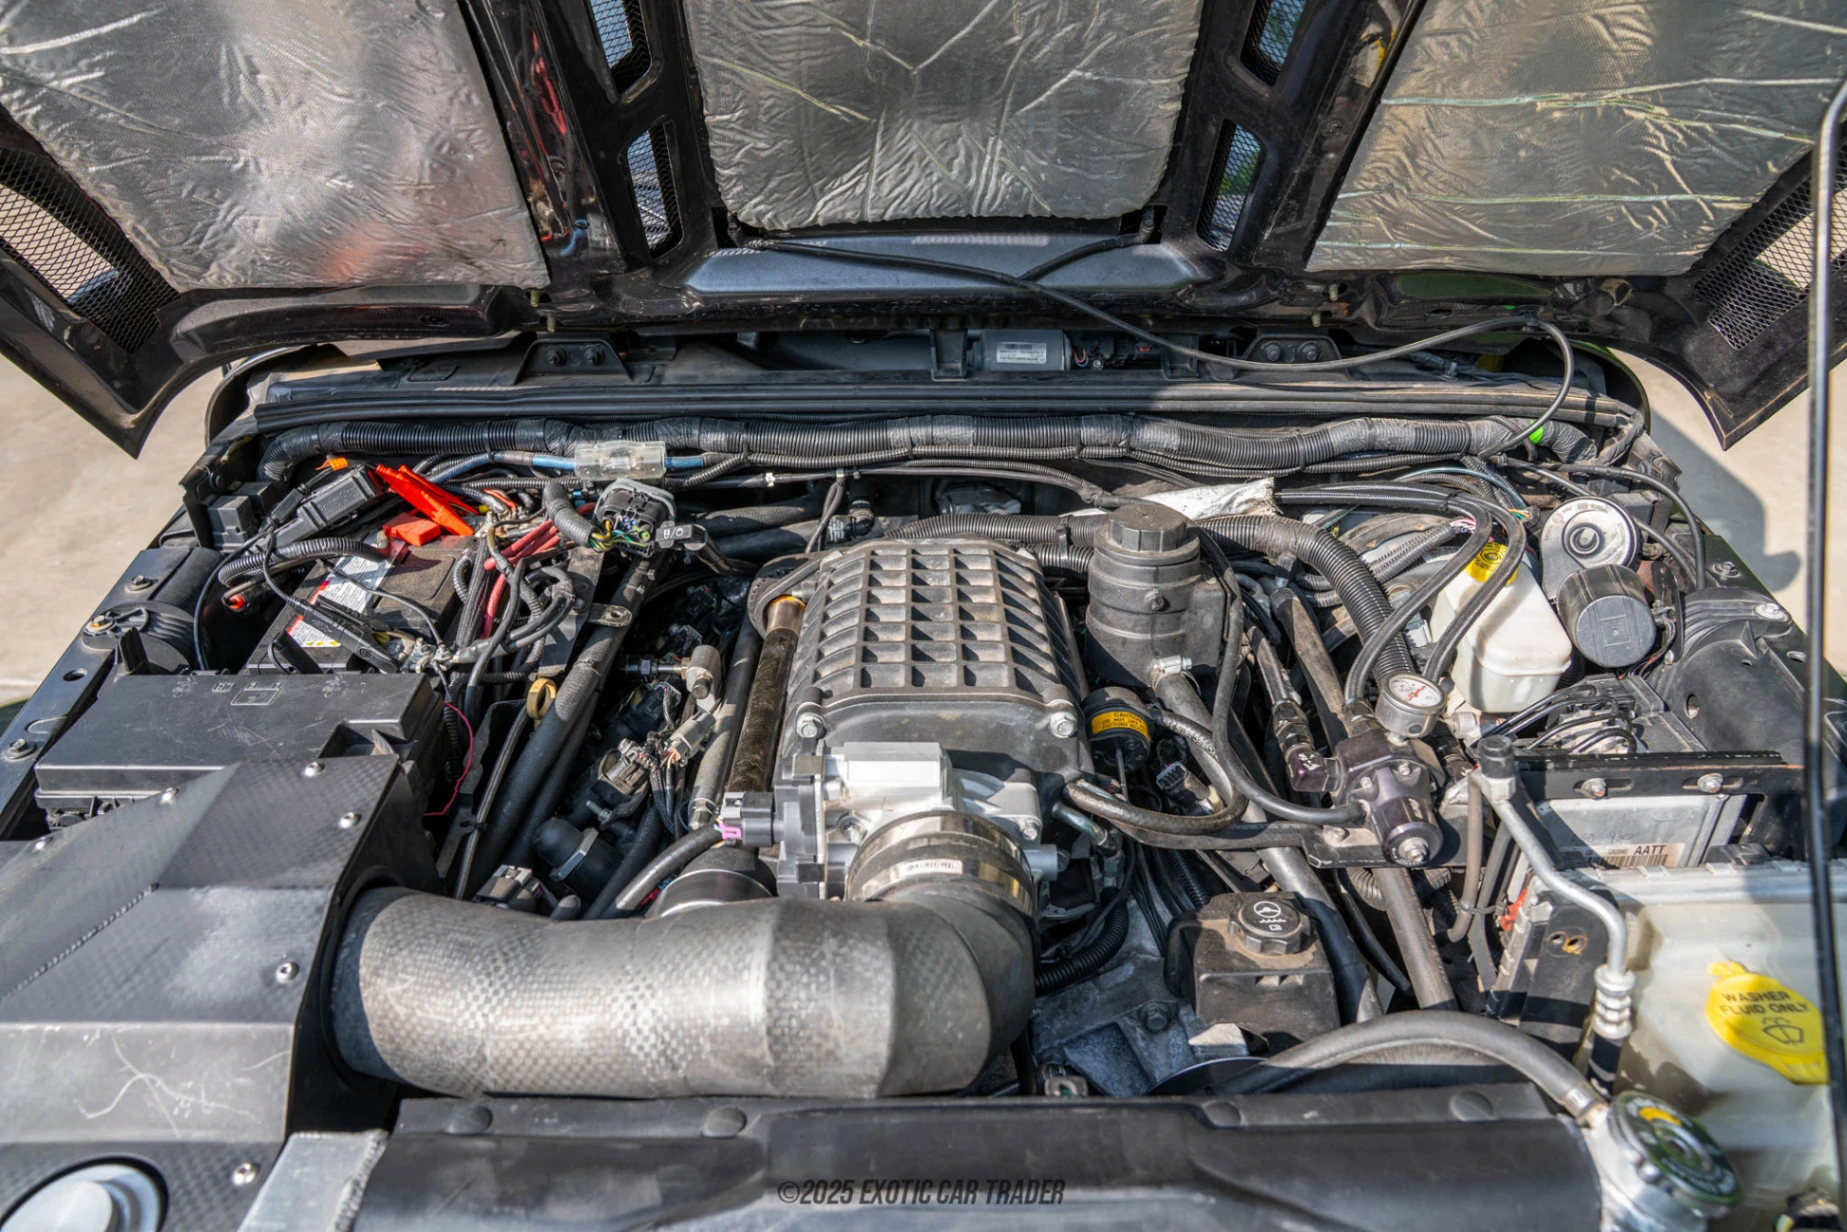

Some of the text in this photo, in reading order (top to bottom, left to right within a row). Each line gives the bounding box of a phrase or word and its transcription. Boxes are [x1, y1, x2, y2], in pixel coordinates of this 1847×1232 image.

[1633, 845, 1666, 856] AATT
[1721, 990, 1791, 1002] WASHER
[1719, 1003, 1808, 1015] FLUID ONLY
